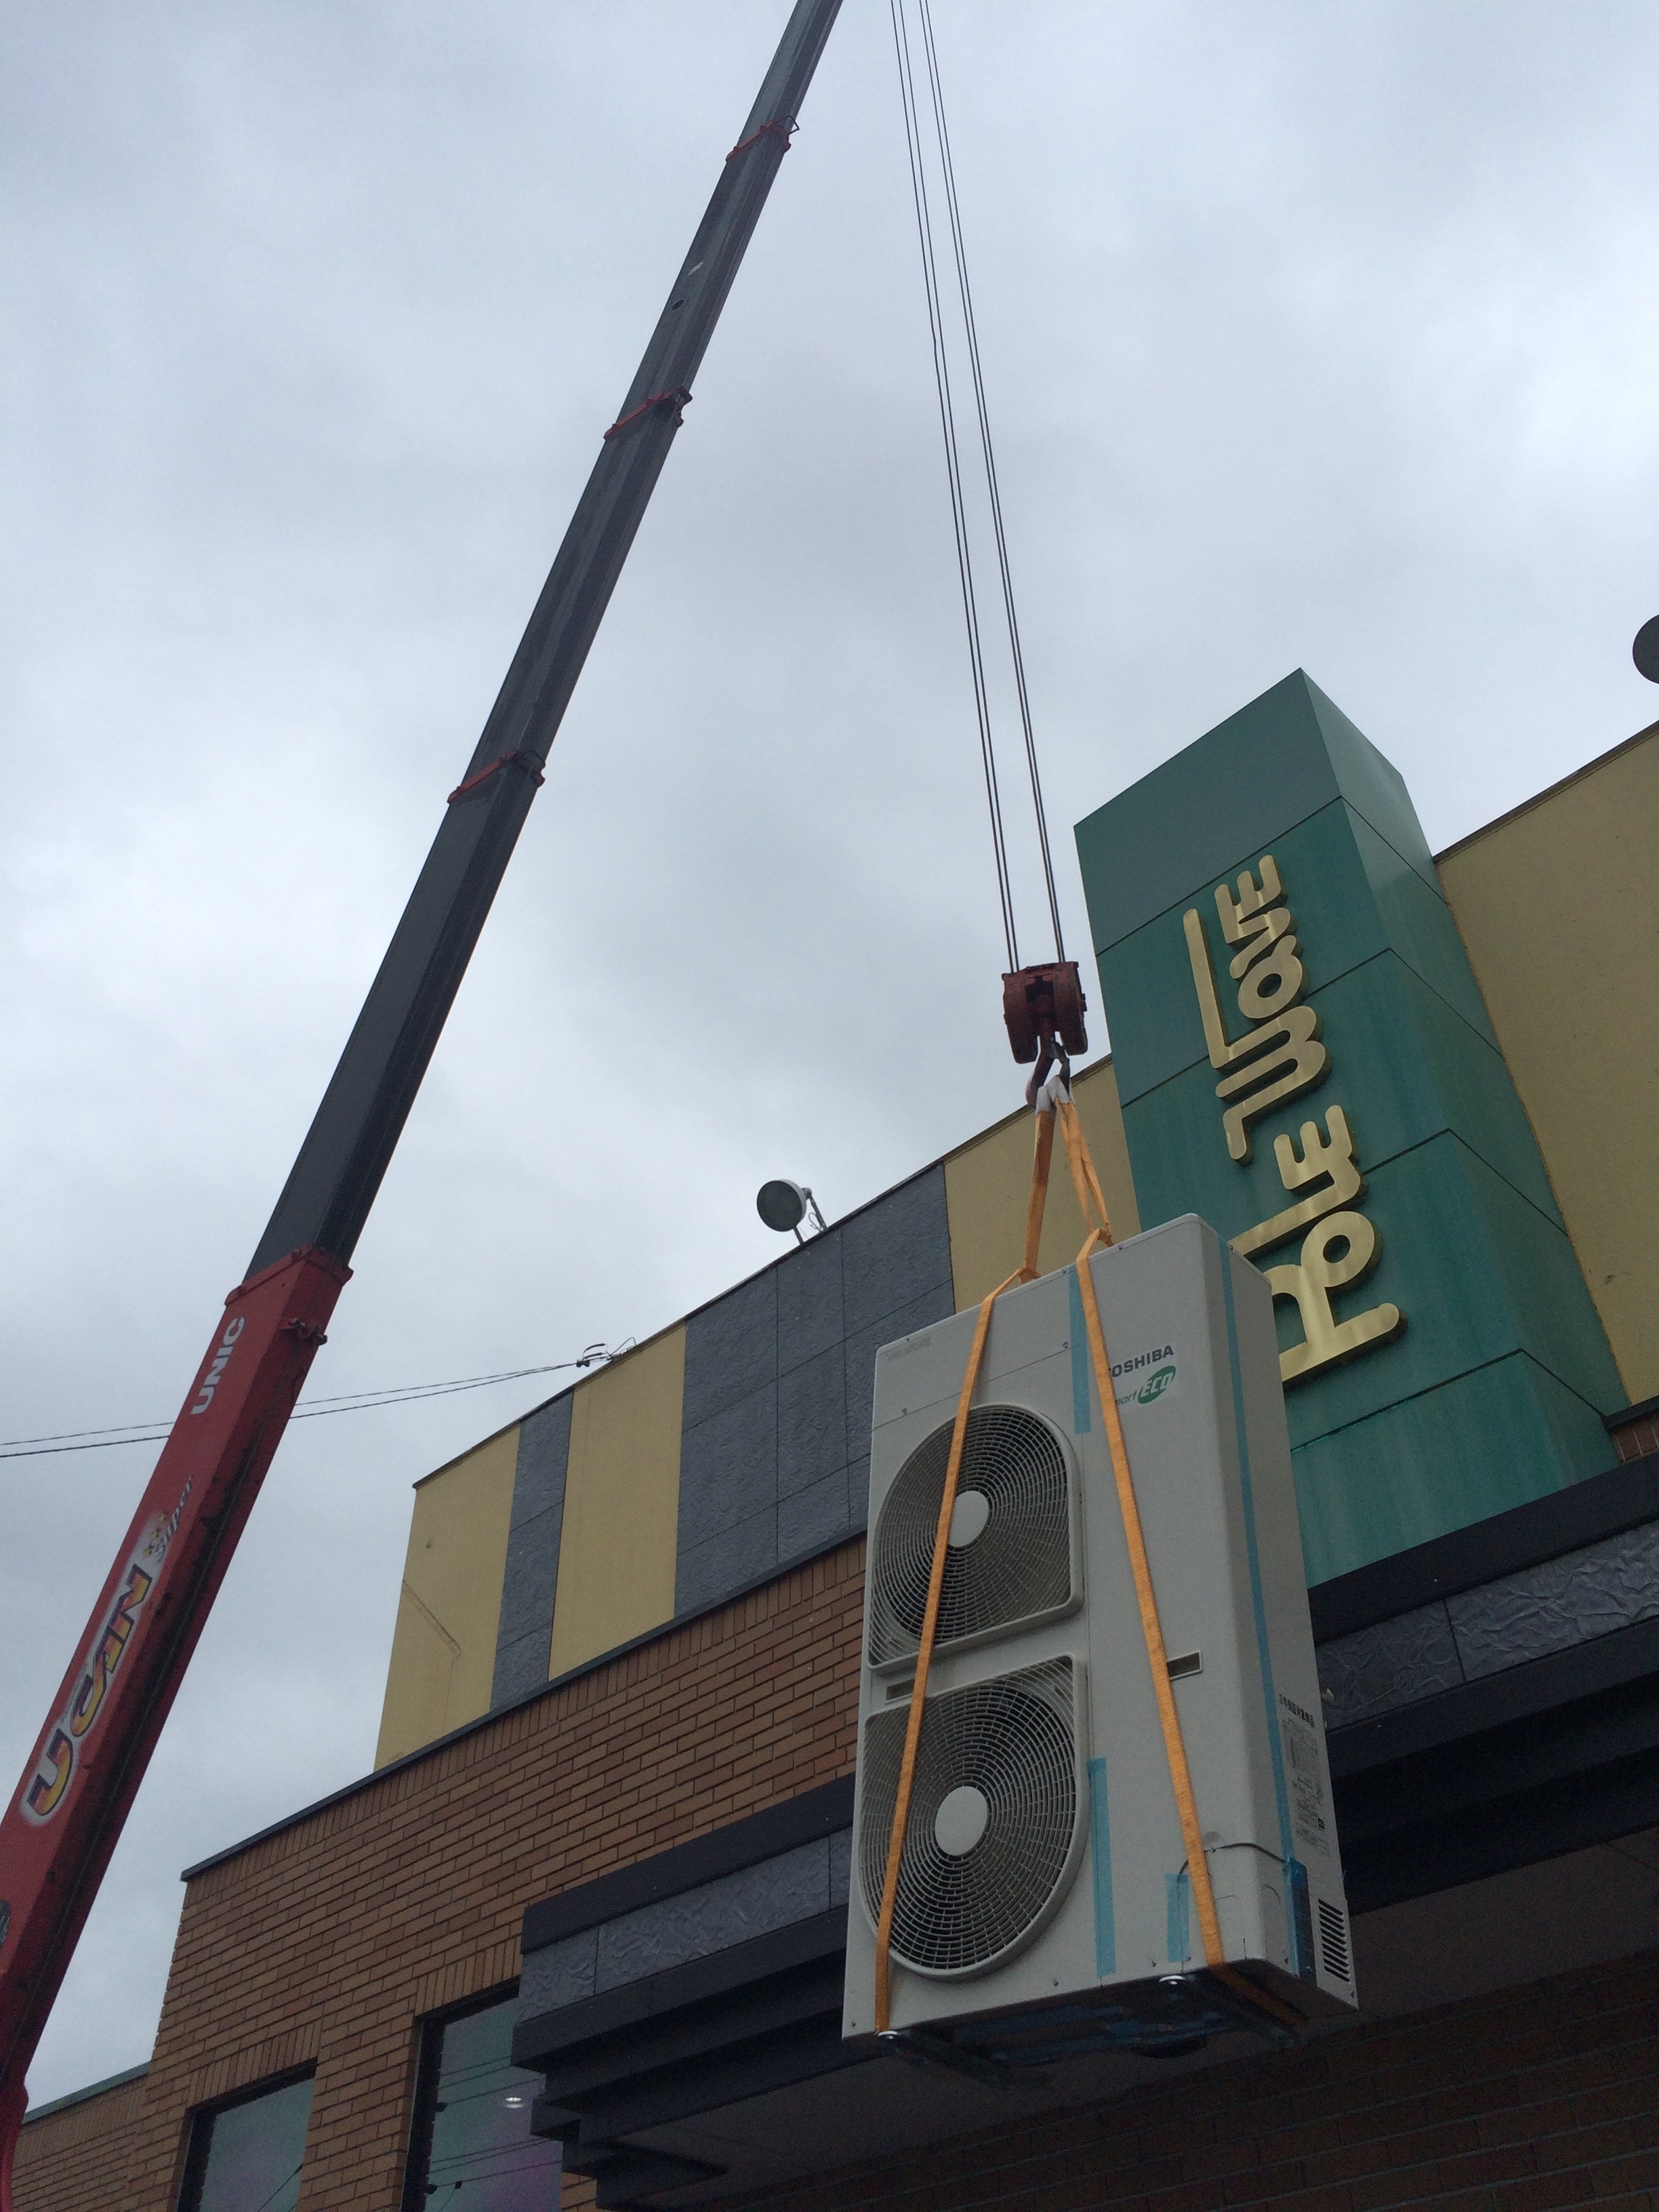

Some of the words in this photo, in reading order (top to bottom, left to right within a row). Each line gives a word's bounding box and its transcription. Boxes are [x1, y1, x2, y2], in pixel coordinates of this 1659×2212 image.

[190, 1316, 245, 1415] UNIC
[1109, 1345, 1174, 1378] OSHIBA
[1139, 1369, 1174, 1401] ECO
